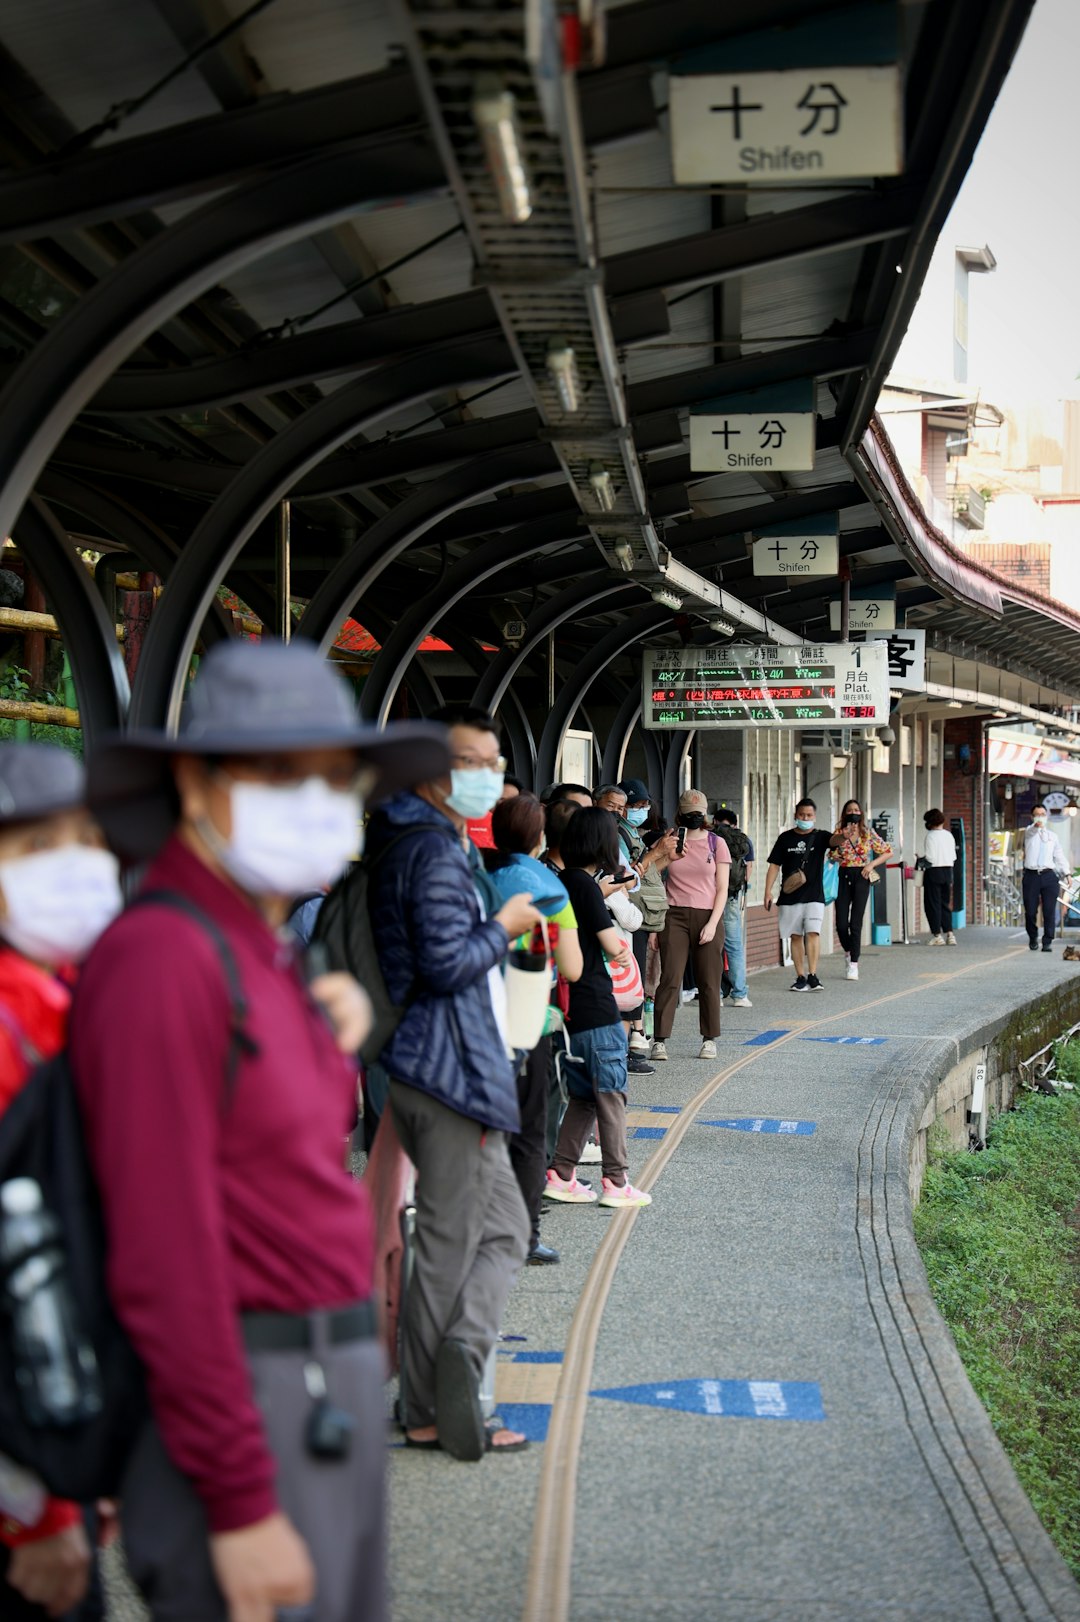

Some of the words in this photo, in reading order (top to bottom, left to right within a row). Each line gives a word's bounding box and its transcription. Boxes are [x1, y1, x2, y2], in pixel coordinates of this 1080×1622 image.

[709, 82, 848, 140] 十分
[739, 145, 822, 172] Shifen
[711, 420, 786, 450] 十分
[727, 453, 772, 467] Shifen
[767, 540, 819, 561] 十分
[778, 563, 810, 573] Shifen
[849, 620, 874, 629] Shifen
[656, 650, 680, 661] 車次
[705, 649, 729, 661] 開往
[754, 647, 778, 660] 時間
[801, 647, 825, 659] 備註
[851, 646, 861, 668] 1
[874, 634, 915, 677] 客
[846, 671, 868, 682] 月台
[844, 683, 870, 693] Plat.
[843, 693, 872, 701] 現在時刻
